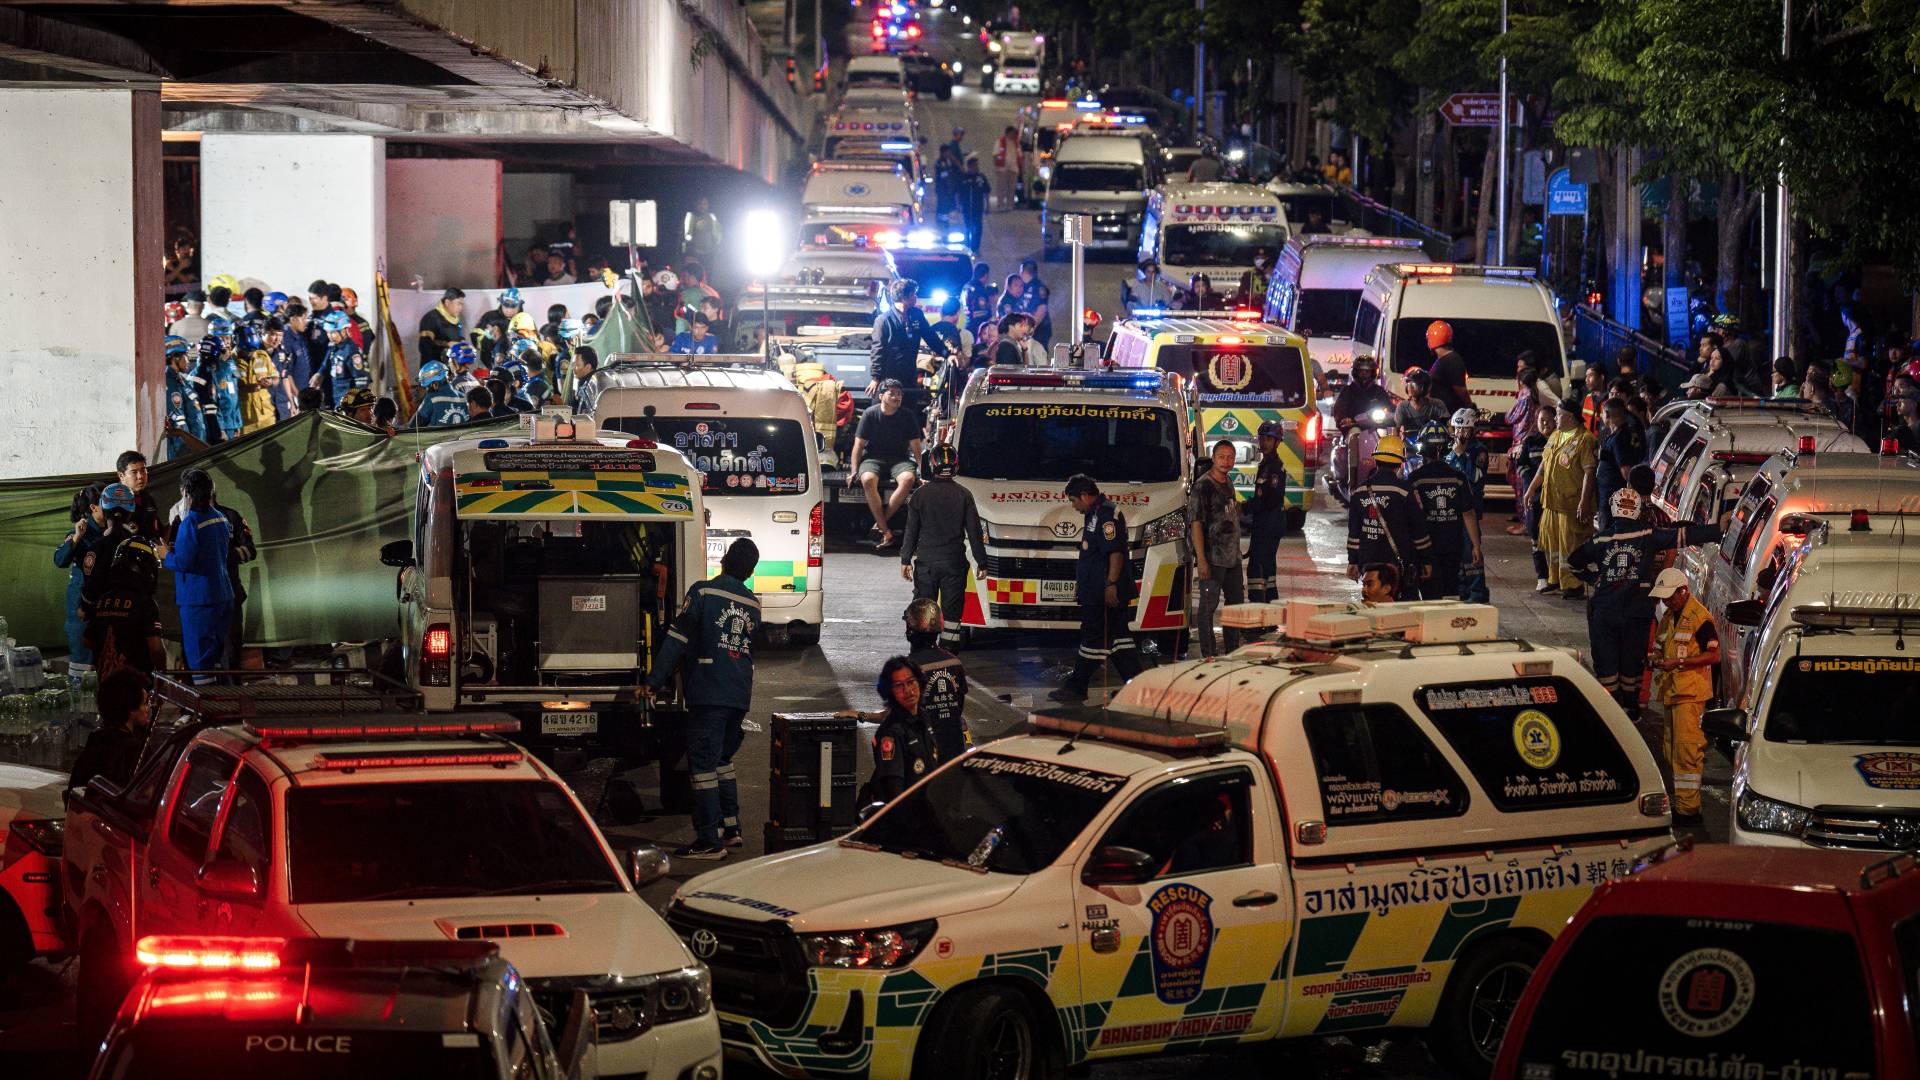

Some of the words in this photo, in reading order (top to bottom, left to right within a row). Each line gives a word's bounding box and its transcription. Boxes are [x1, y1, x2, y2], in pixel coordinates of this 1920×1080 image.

[674, 431, 738, 448] อาสาฯ
[664, 501, 684, 510] 76
[569, 714, 596, 725] 4216
[1304, 849, 1580, 917] อาสามูลนิธิป่อเต็กตึ๊ง
[1151, 886, 1209, 913] RESCUE
[1082, 918, 1120, 930] HILUX
[245, 1034, 352, 1054] POLICE
